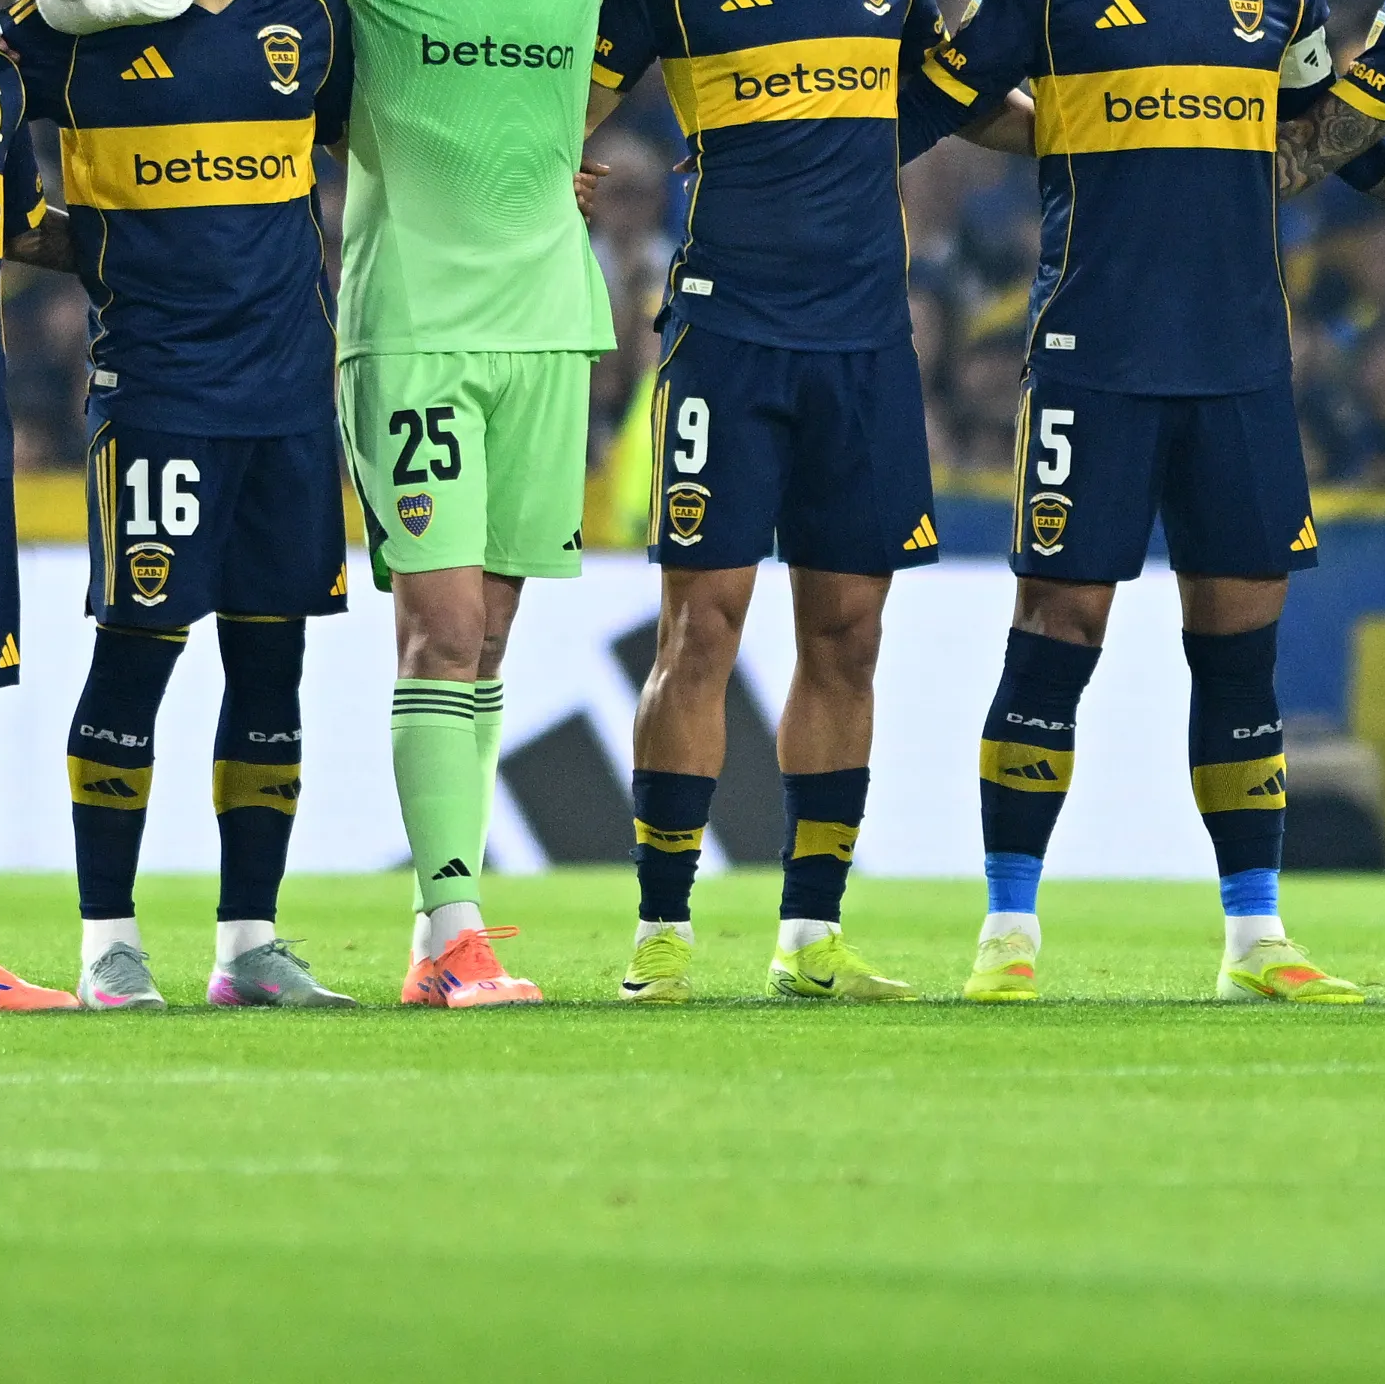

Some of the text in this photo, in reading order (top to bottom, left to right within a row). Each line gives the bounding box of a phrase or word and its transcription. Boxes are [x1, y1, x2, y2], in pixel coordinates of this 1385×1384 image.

[1235, 1, 1258, 12] CABJ
[271, 53, 294, 62] CABJ
[422, 33, 574, 70] betsson
[733, 63, 891, 102] betsson
[1104, 88, 1265, 123] betsson
[134, 149, 297, 186] betsson
[388, 406, 462, 486] 25
[674, 397, 711, 474] 9
[1037, 409, 1075, 485] 5
[125, 459, 201, 536] 16
[401, 506, 431, 519] CABJ
[674, 507, 699, 517] CABJ
[1037, 517, 1061, 527] CABJ
[137, 568, 163, 577] CABJ
[79, 724, 149, 748] CABJ
